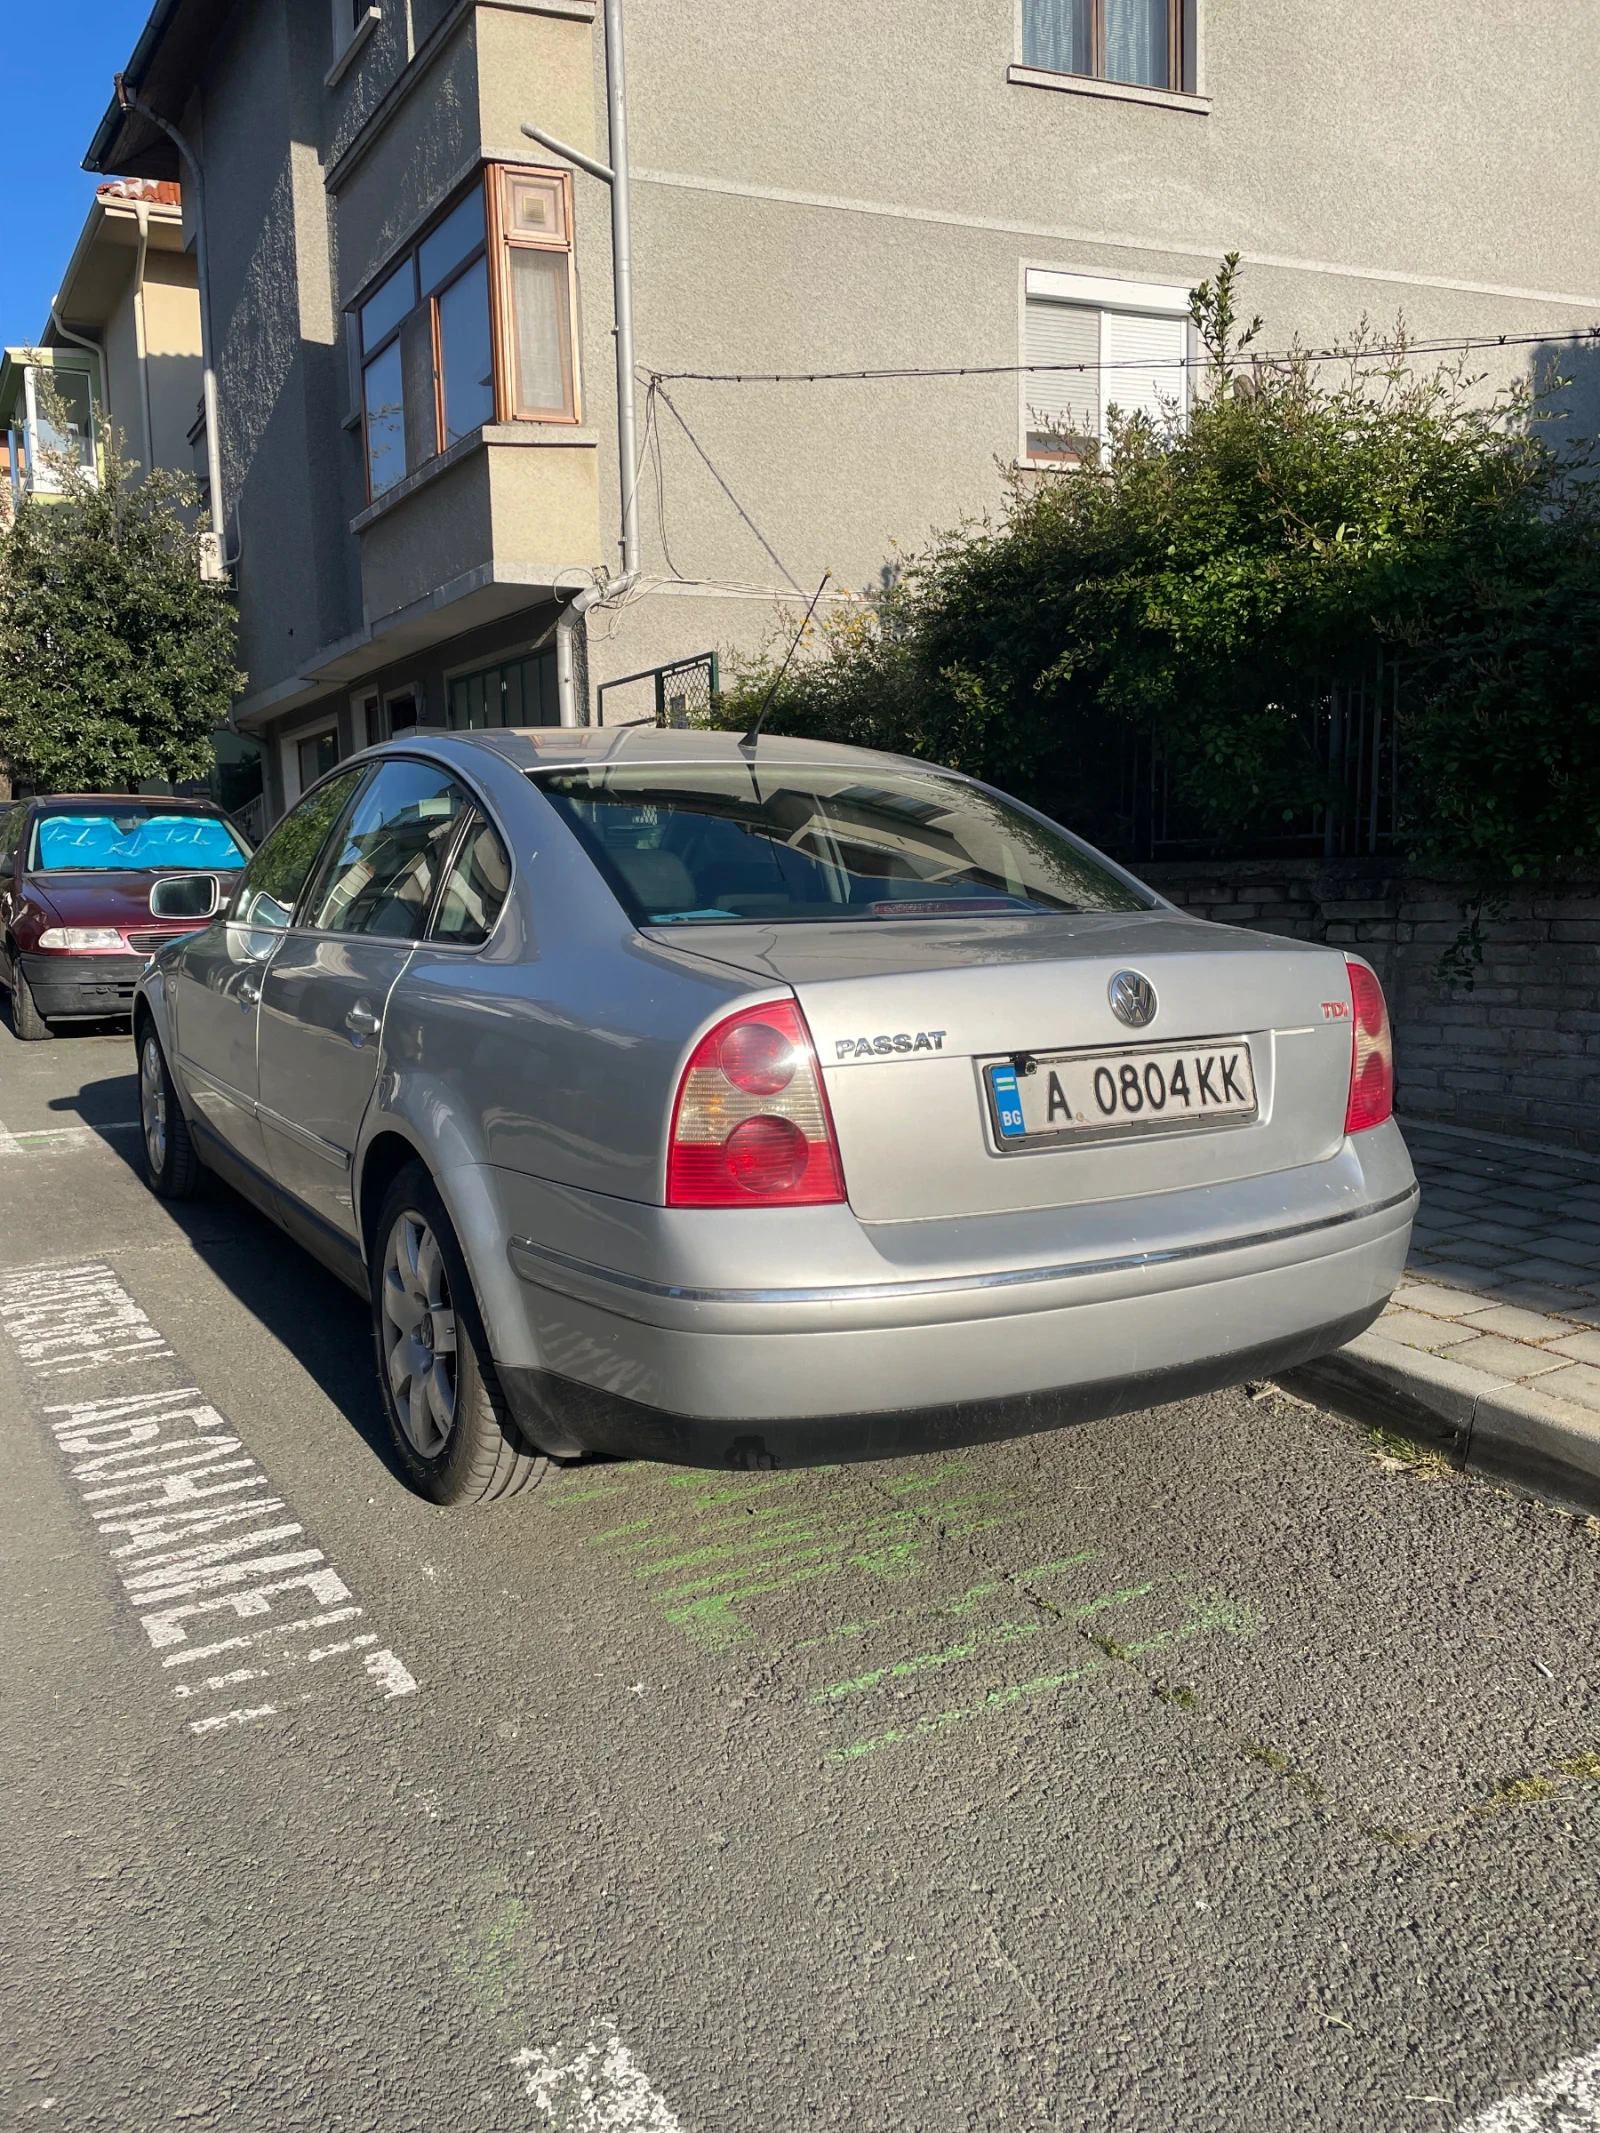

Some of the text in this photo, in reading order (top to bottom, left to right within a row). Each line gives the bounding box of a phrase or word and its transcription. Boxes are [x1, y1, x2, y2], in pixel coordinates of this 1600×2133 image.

[1321, 1001, 1349, 1019] TDI
[835, 1030, 947, 1060] PASSAT
[1002, 1109, 1022, 1128] BG
